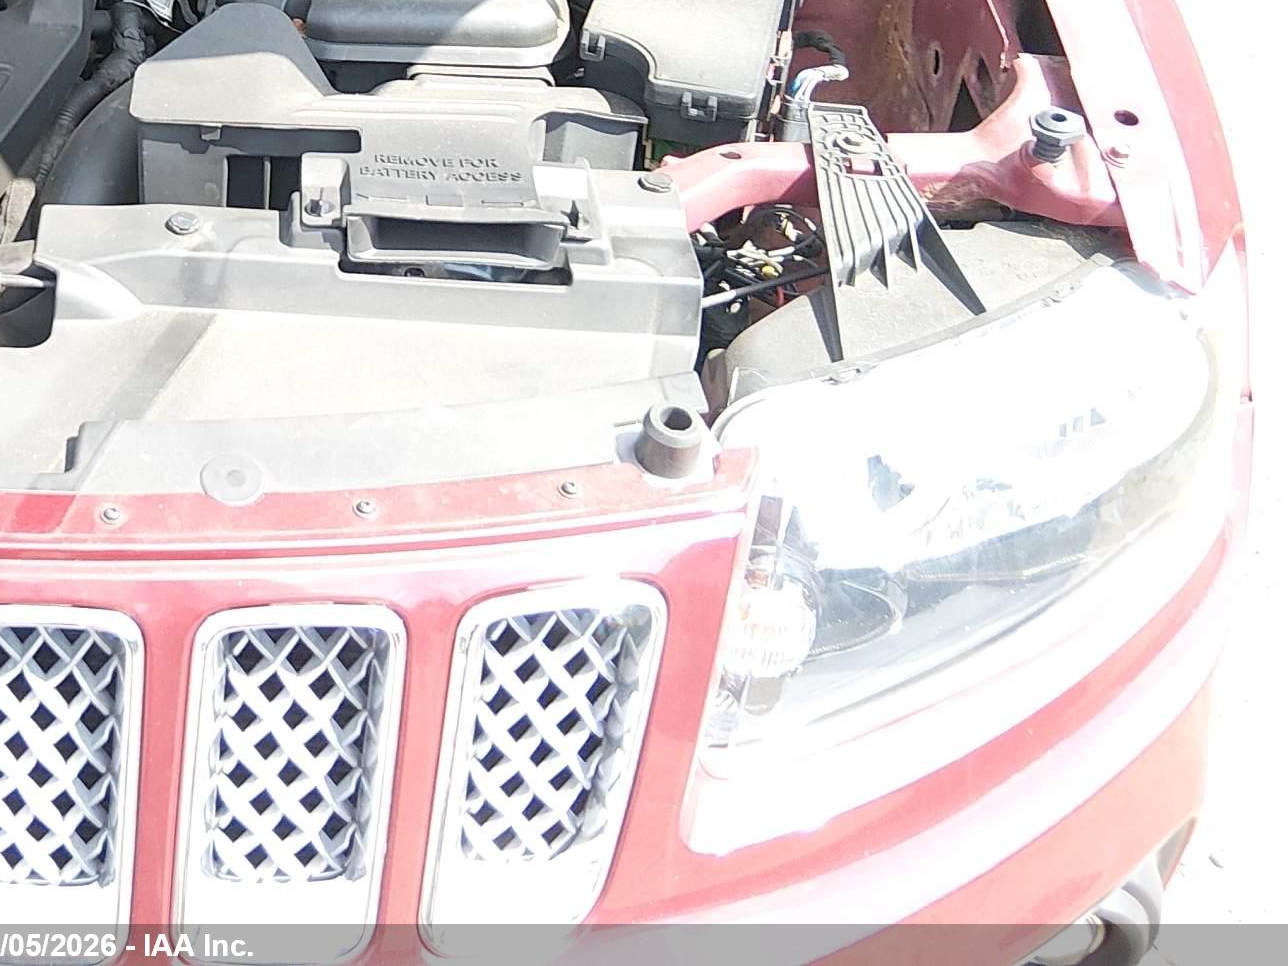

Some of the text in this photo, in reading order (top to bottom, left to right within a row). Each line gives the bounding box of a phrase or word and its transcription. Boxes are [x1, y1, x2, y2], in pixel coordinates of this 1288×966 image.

[374, 153, 499, 169] REMOVE FOR
[359, 165, 523, 182] BATTERY ACCESS
